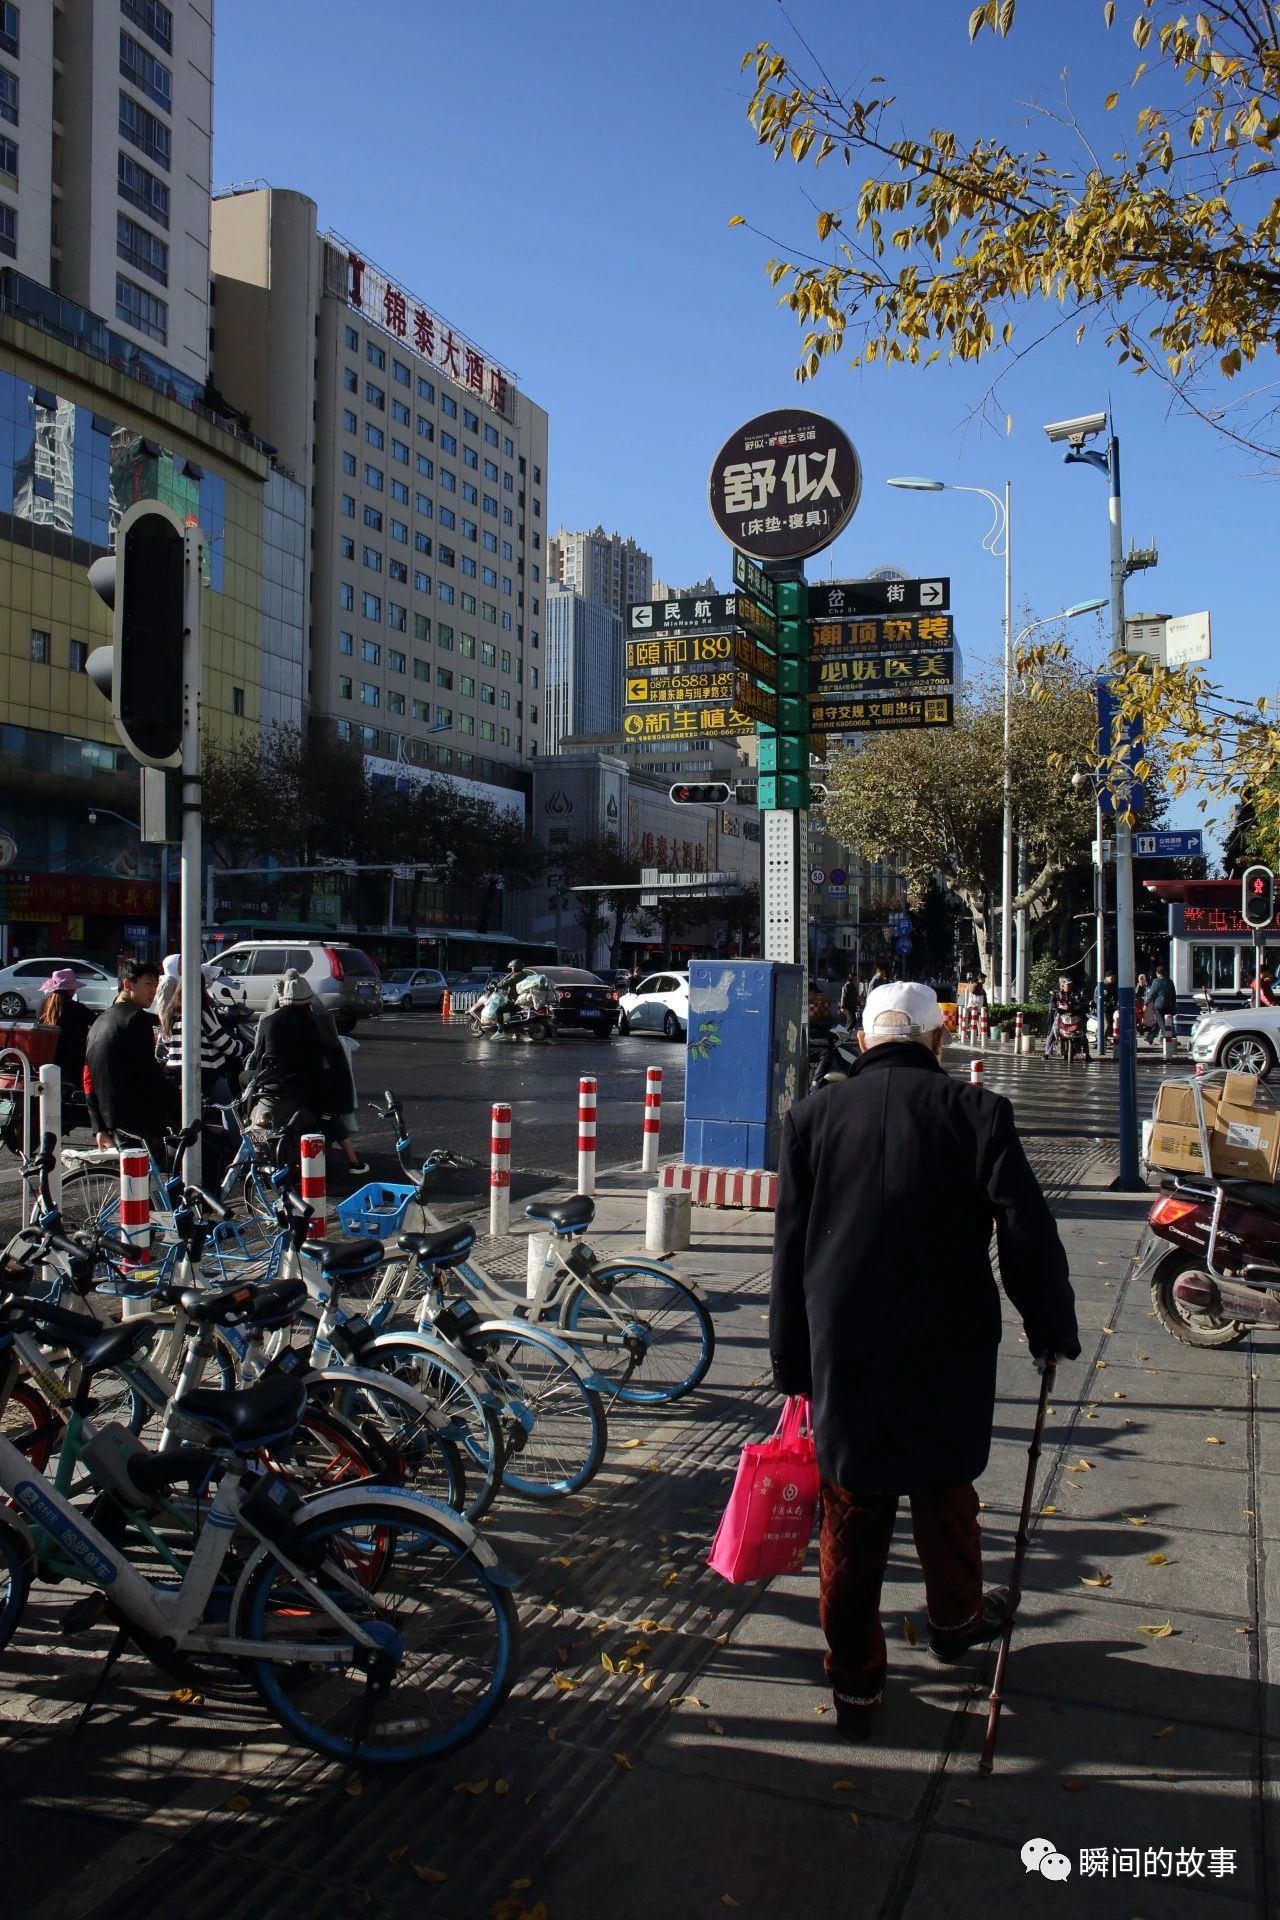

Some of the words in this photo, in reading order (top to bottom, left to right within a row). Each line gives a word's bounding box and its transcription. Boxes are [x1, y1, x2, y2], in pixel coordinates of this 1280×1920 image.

[383, 283, 508, 413] 锦泰大酒店
[722, 447, 842, 515] 舒似
[702, 616, 712, 624] Rd
[812, 616, 949, 647] 潮顶软装
[650, 681, 671, 689] 0871
[671, 675, 708, 689] 6588
[868, 701, 922, 719] 文明出行
[813, 872, 823, 881] 50
